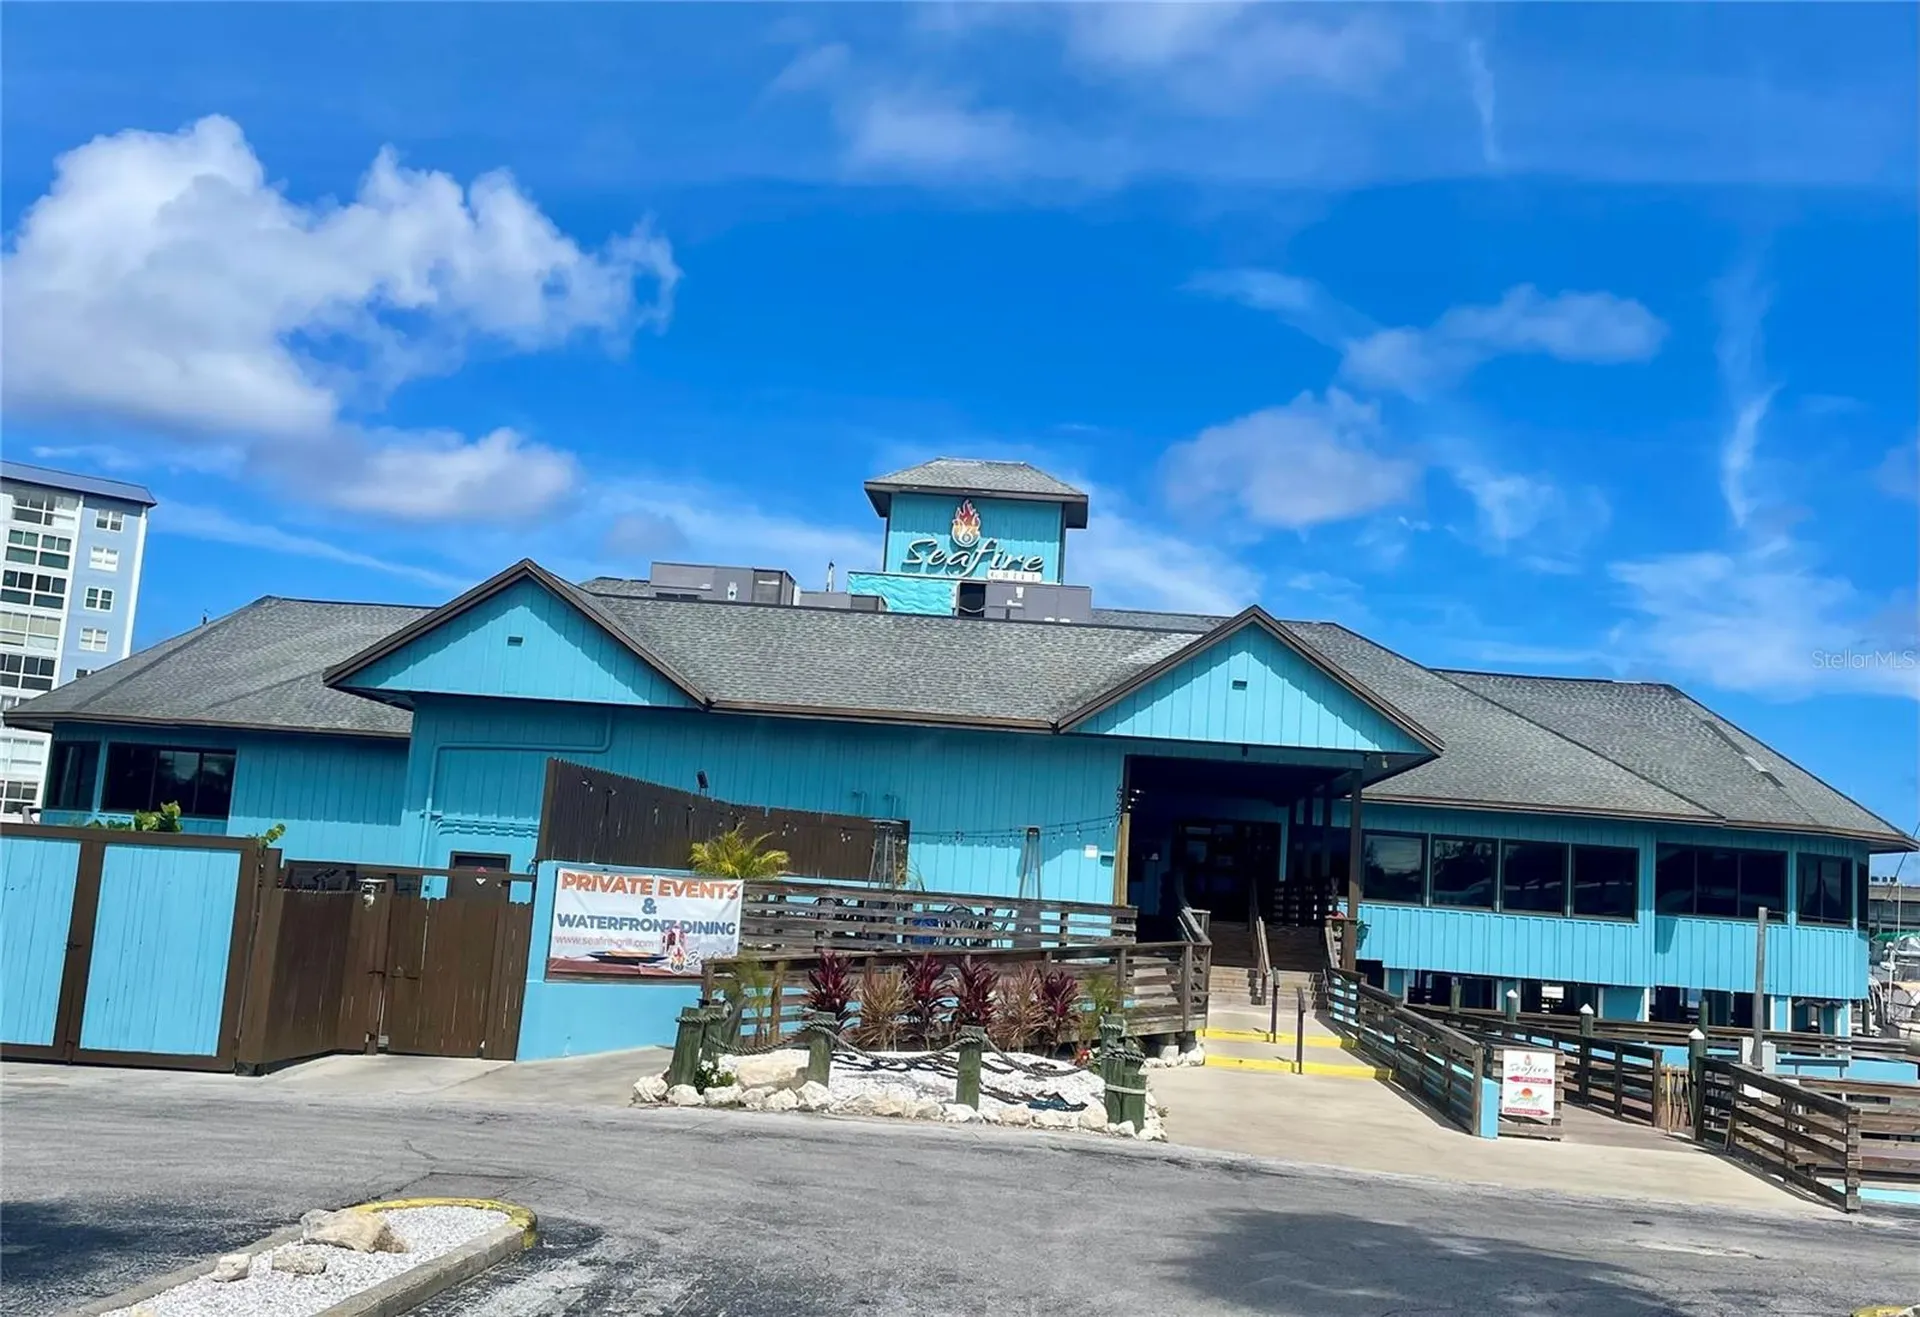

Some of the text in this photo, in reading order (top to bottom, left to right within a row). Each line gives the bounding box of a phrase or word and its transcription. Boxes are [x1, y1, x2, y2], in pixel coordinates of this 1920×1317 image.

[902, 538, 1045, 578] Seafire
[561, 872, 739, 900] PRIVATE EVENTS
[641, 897, 657, 915] &
[556, 913, 736, 936] WATERFRONT DINING
